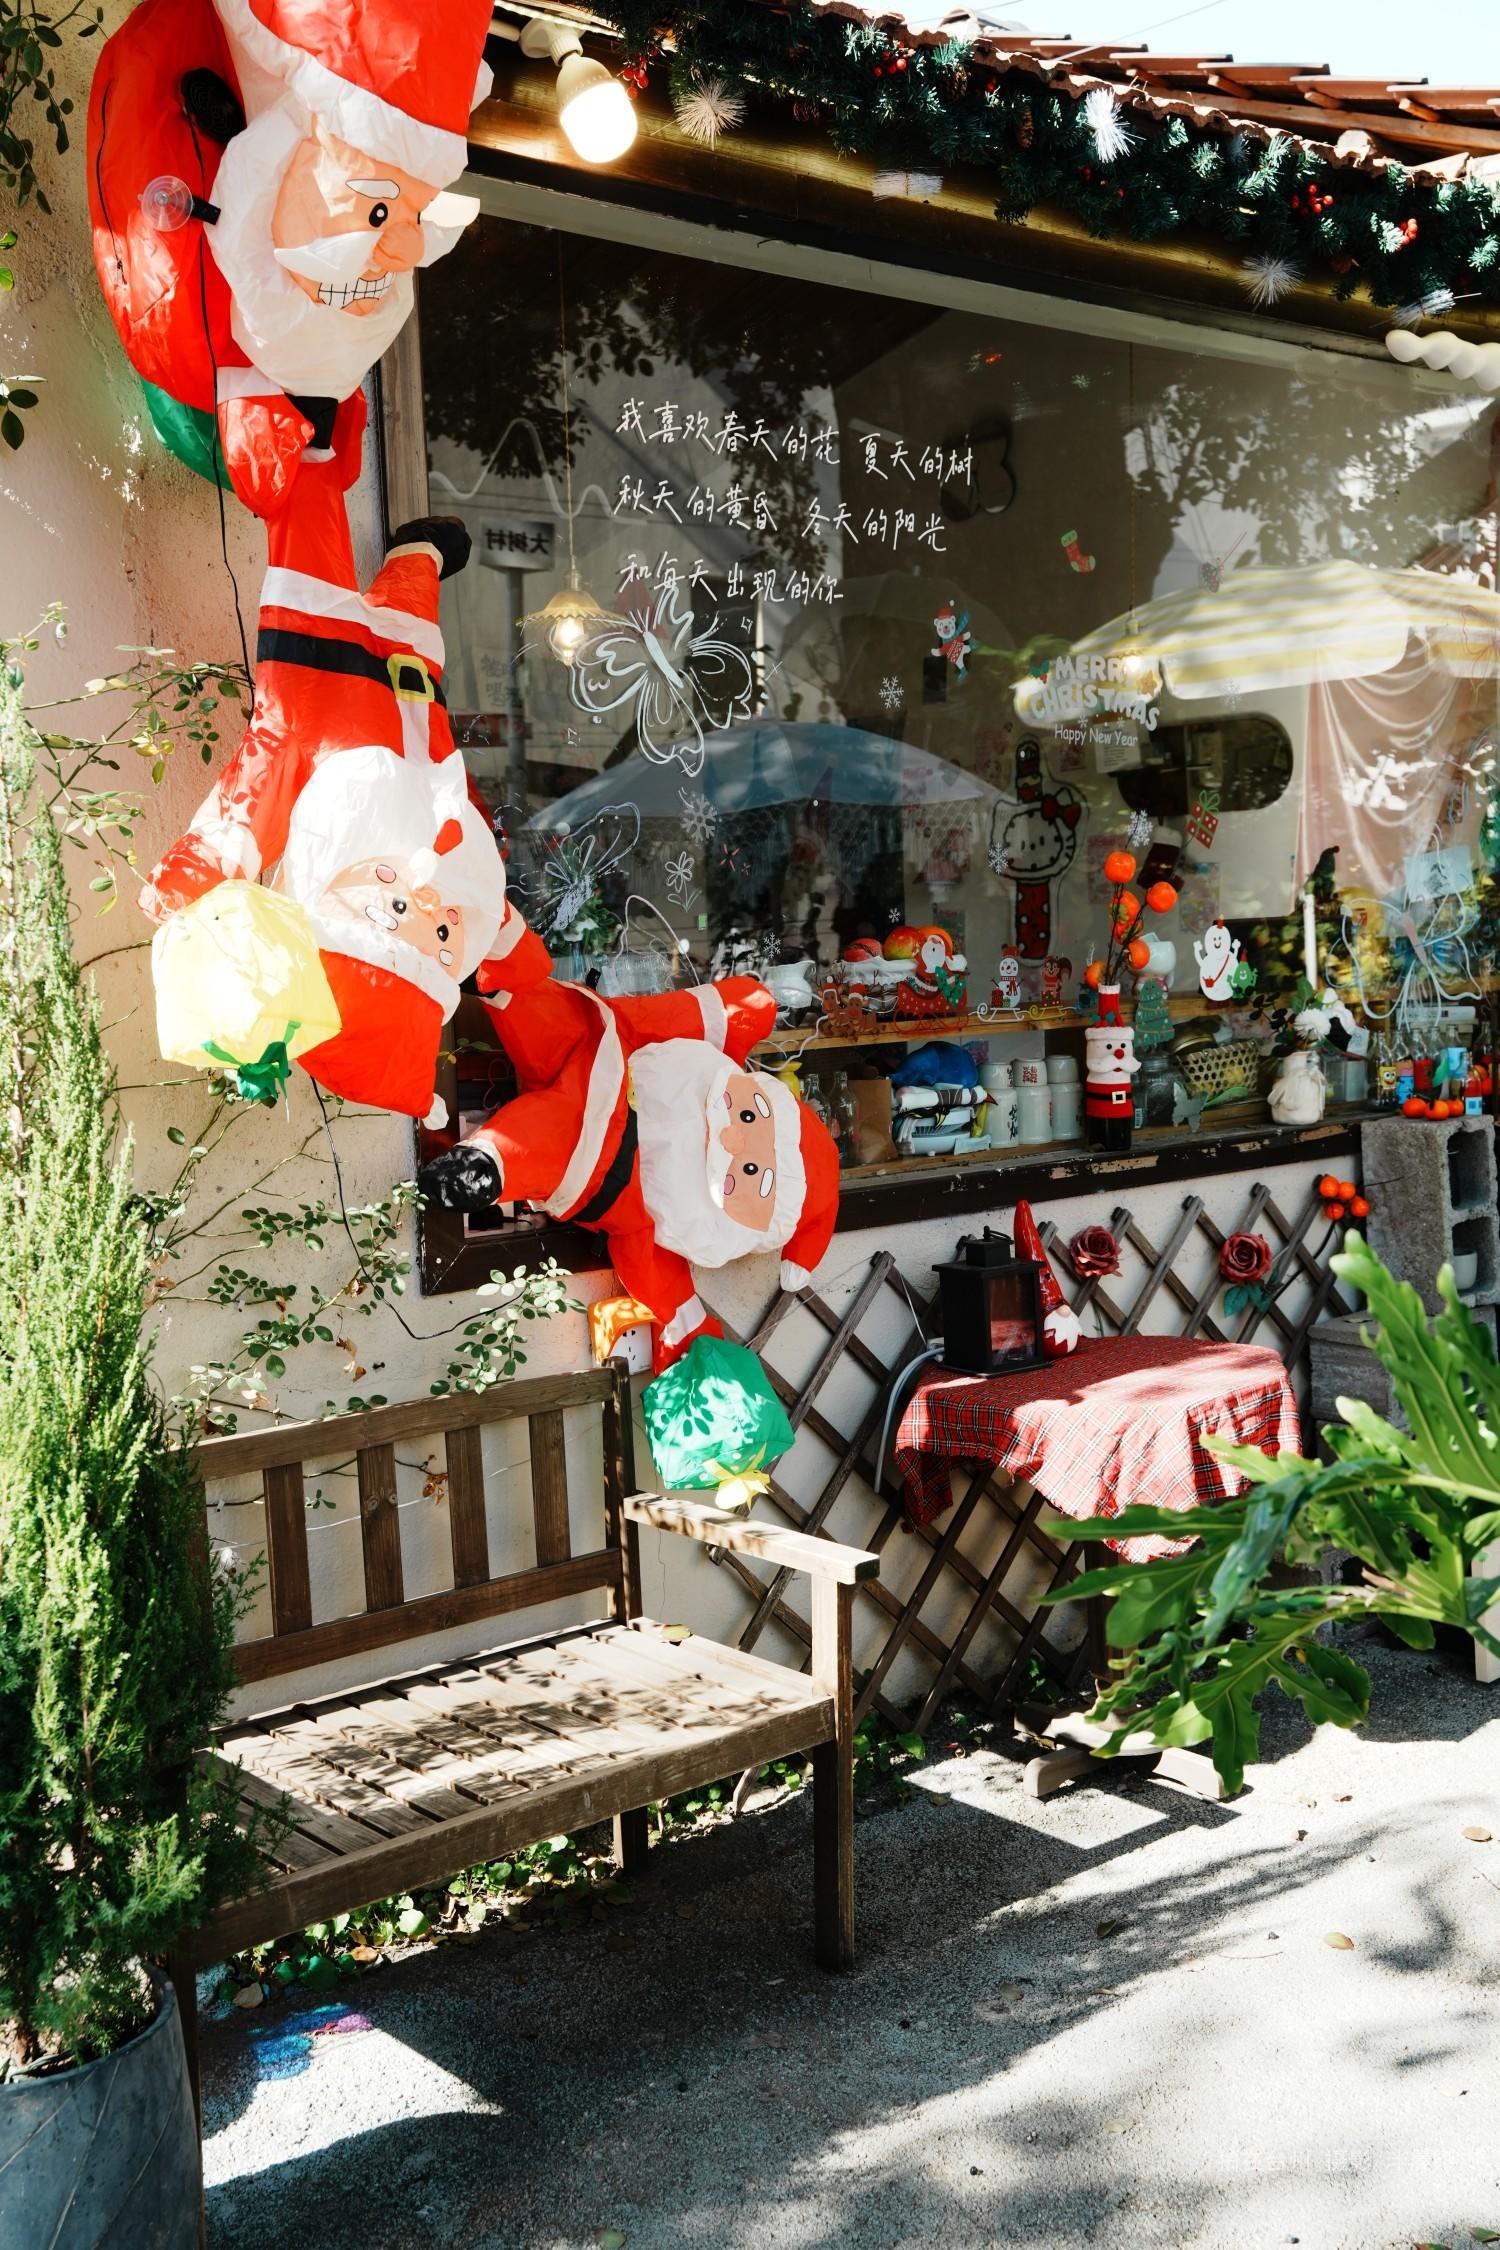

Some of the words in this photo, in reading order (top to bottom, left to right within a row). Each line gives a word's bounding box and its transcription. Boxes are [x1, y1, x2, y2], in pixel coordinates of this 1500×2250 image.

[616, 398, 840, 465] 我喜欢春天的花
[859, 433, 973, 486] 夏天的树
[614, 475, 778, 532] 秋天的黄昏
[801, 498, 947, 552] 冬天的阳光
[1031, 683, 1160, 731] CHRISTMAS
[1055, 725, 1086, 746] Happy
[1089, 727, 1112, 745] New
[1114, 731, 1138, 747] Year
